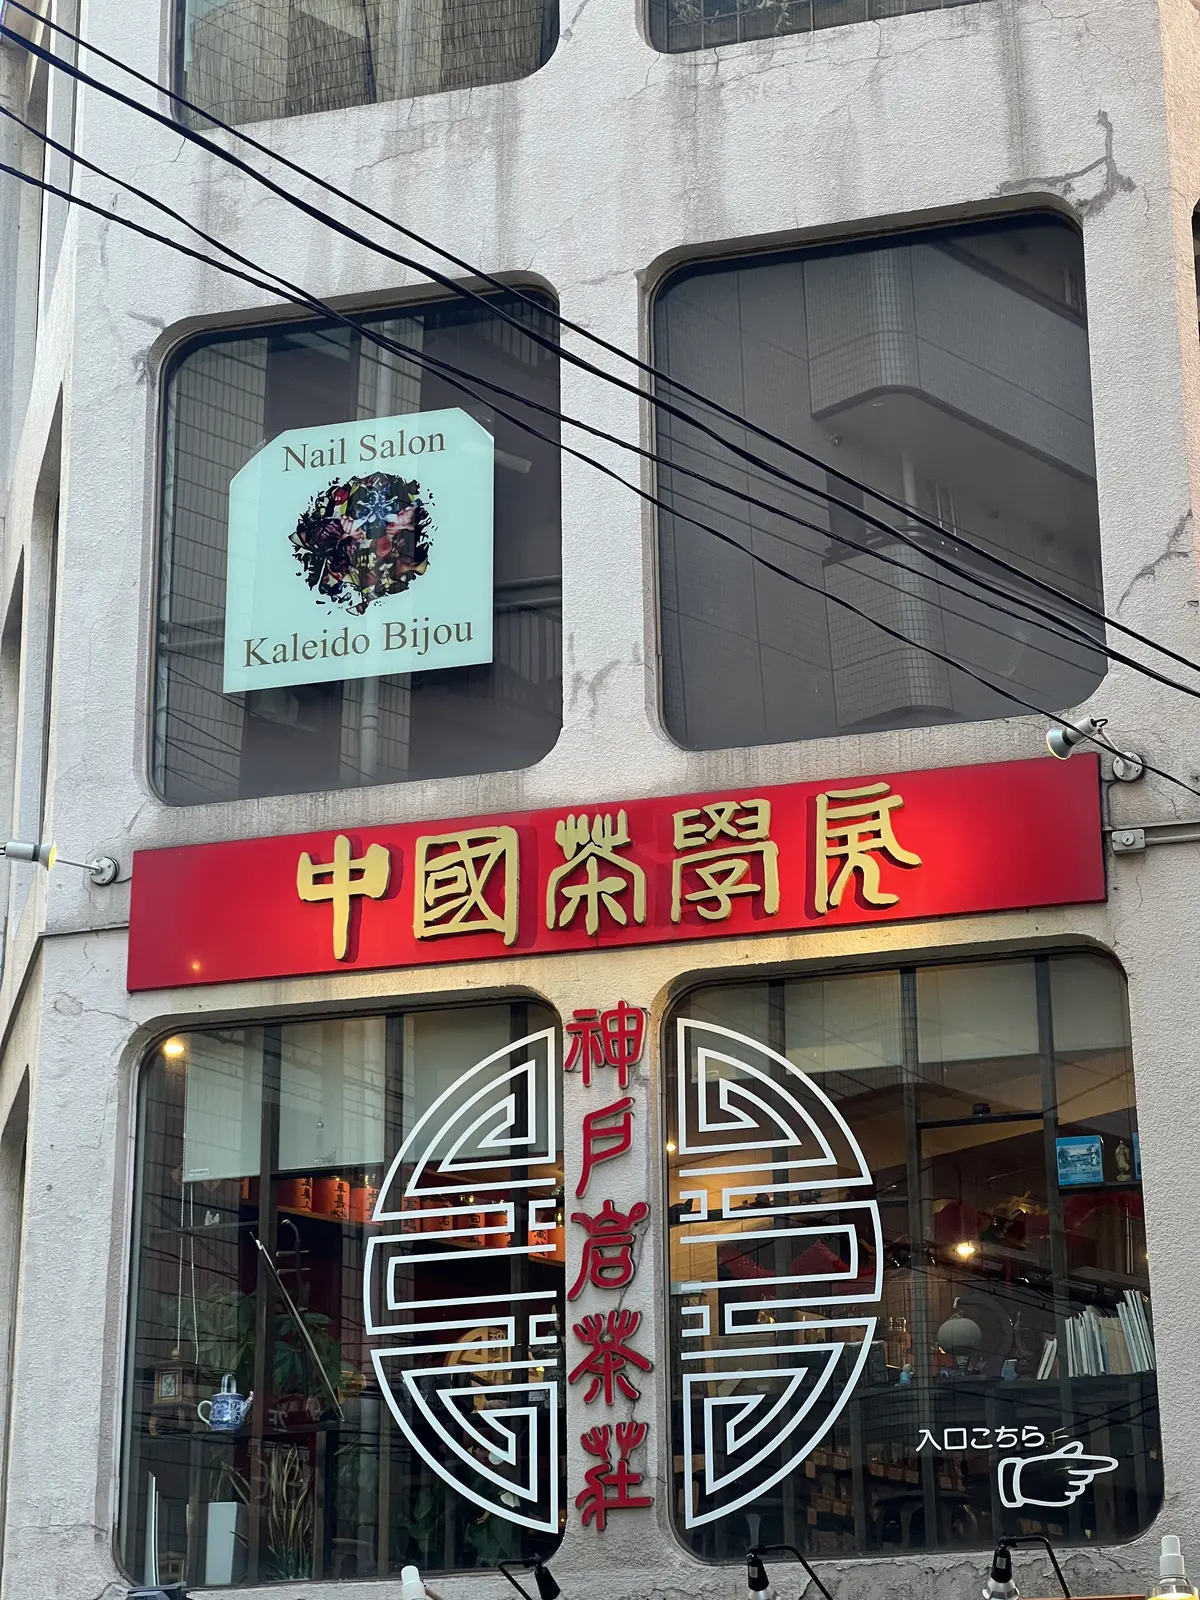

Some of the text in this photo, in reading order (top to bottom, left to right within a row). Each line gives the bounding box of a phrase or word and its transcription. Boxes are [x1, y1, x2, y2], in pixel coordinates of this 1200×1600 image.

[282, 429, 447, 473] Nail Salon
[242, 616, 474, 668] Kaleido Bijou
[915, 1425, 1046, 1452] 入口こちら
